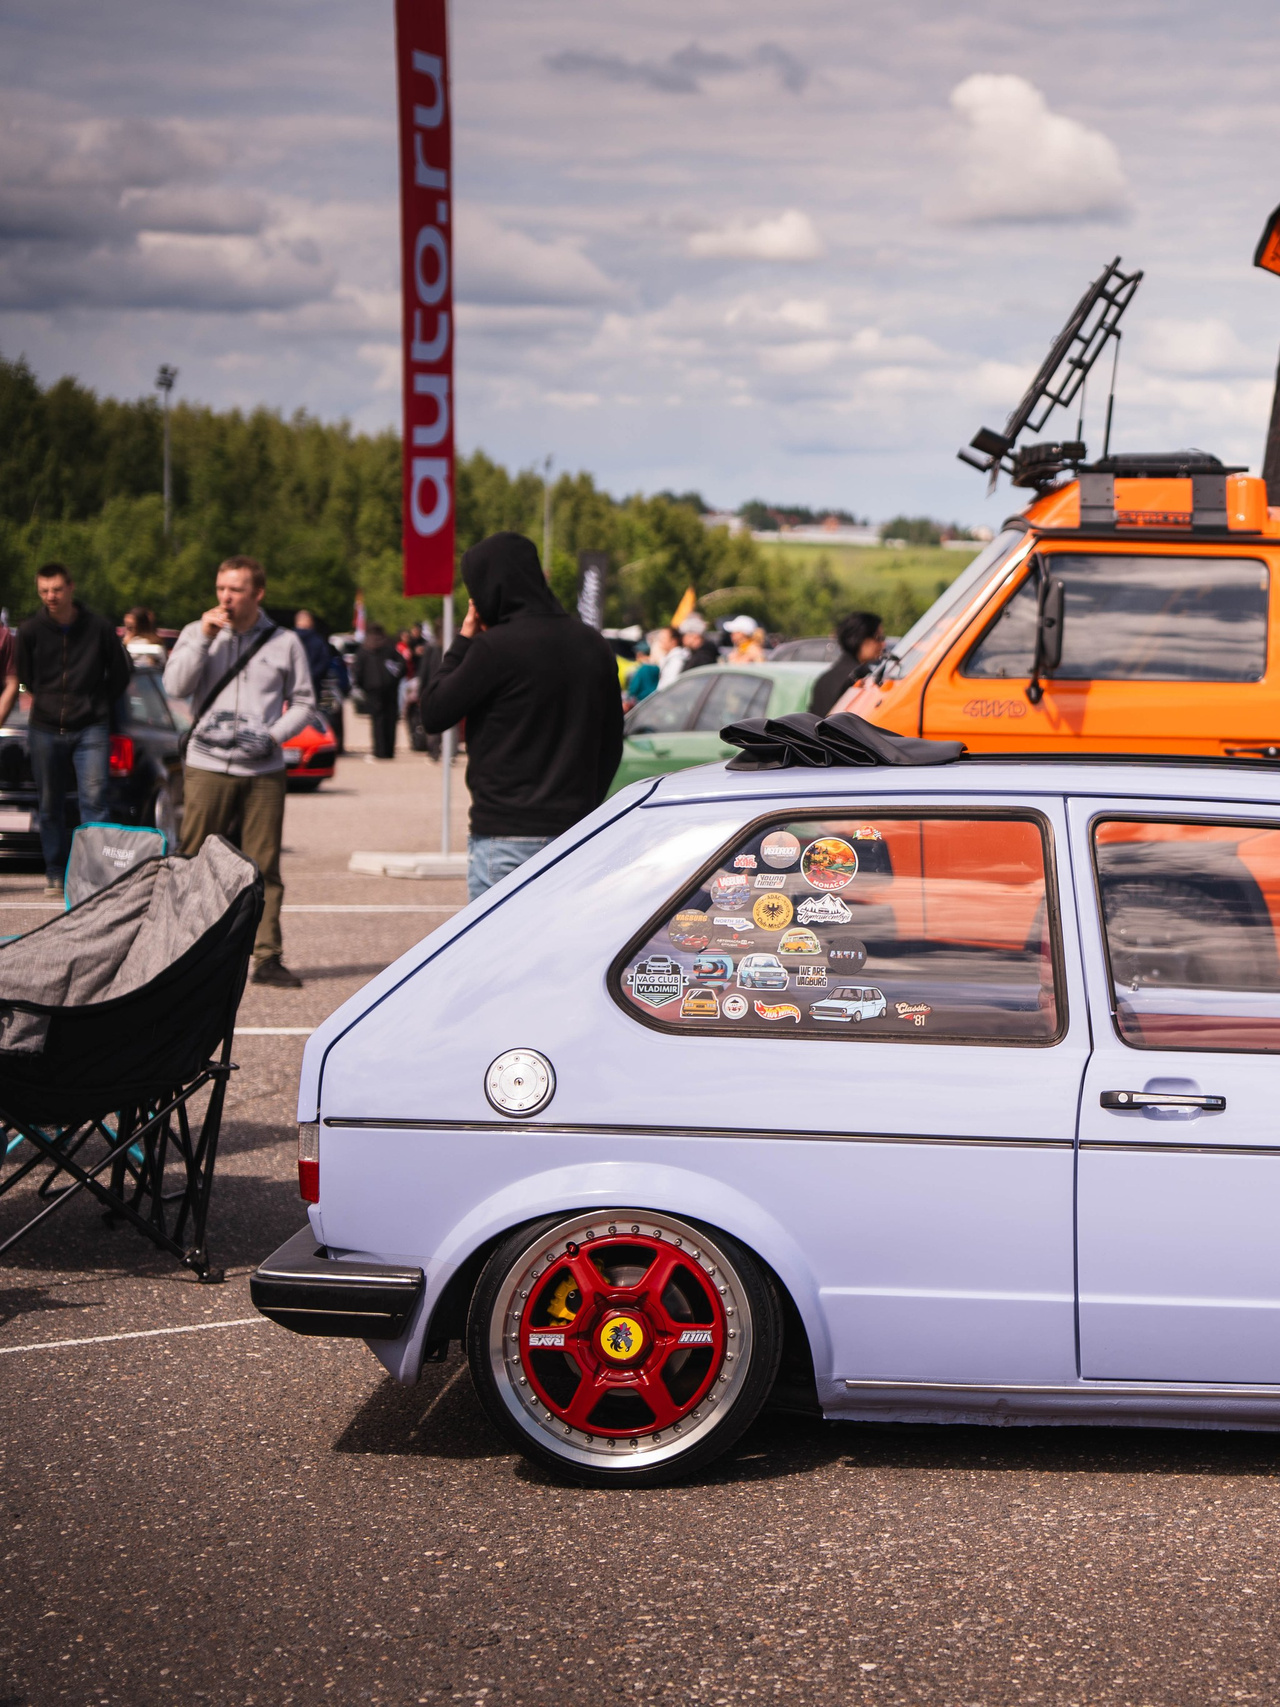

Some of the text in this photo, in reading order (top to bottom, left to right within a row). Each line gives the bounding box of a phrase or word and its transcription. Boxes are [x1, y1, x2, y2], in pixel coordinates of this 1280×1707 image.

[411, 49, 450, 537] auto.ru
[963, 699, 1027, 718] 4WD
[812, 879, 845, 888] MONACO
[800, 966, 825, 976] WE ARE
[658, 976, 679, 984] CLUB
[797, 977, 827, 986] VAGBURG
[895, 1002, 931, 1014] Classic
[913, 1014, 925, 1026] '81
[529, 1337, 564, 1346] RAYS
